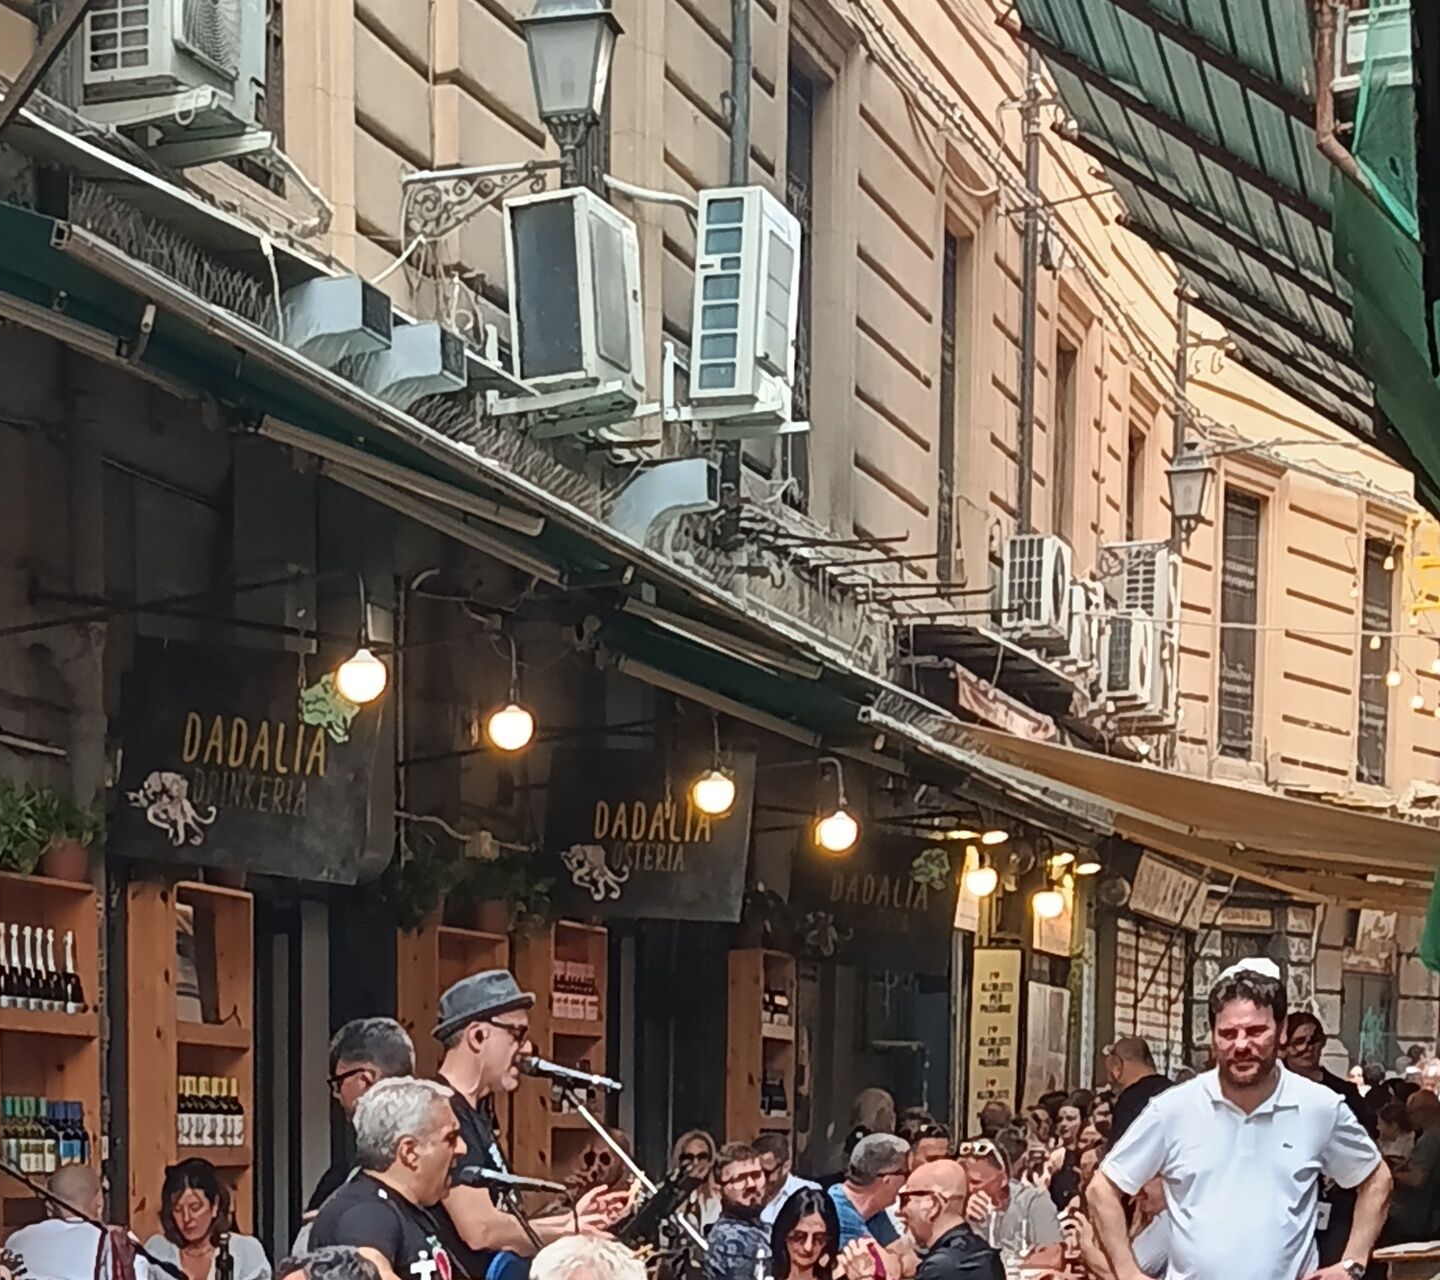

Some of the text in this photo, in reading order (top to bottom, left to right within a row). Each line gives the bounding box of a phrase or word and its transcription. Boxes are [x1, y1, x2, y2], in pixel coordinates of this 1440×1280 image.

[182, 711, 326, 777] DADALIA
[593, 799, 712, 843] DADALIA
[611, 842, 685, 872] OSTERIA
[829, 868, 929, 911] DADALIA
